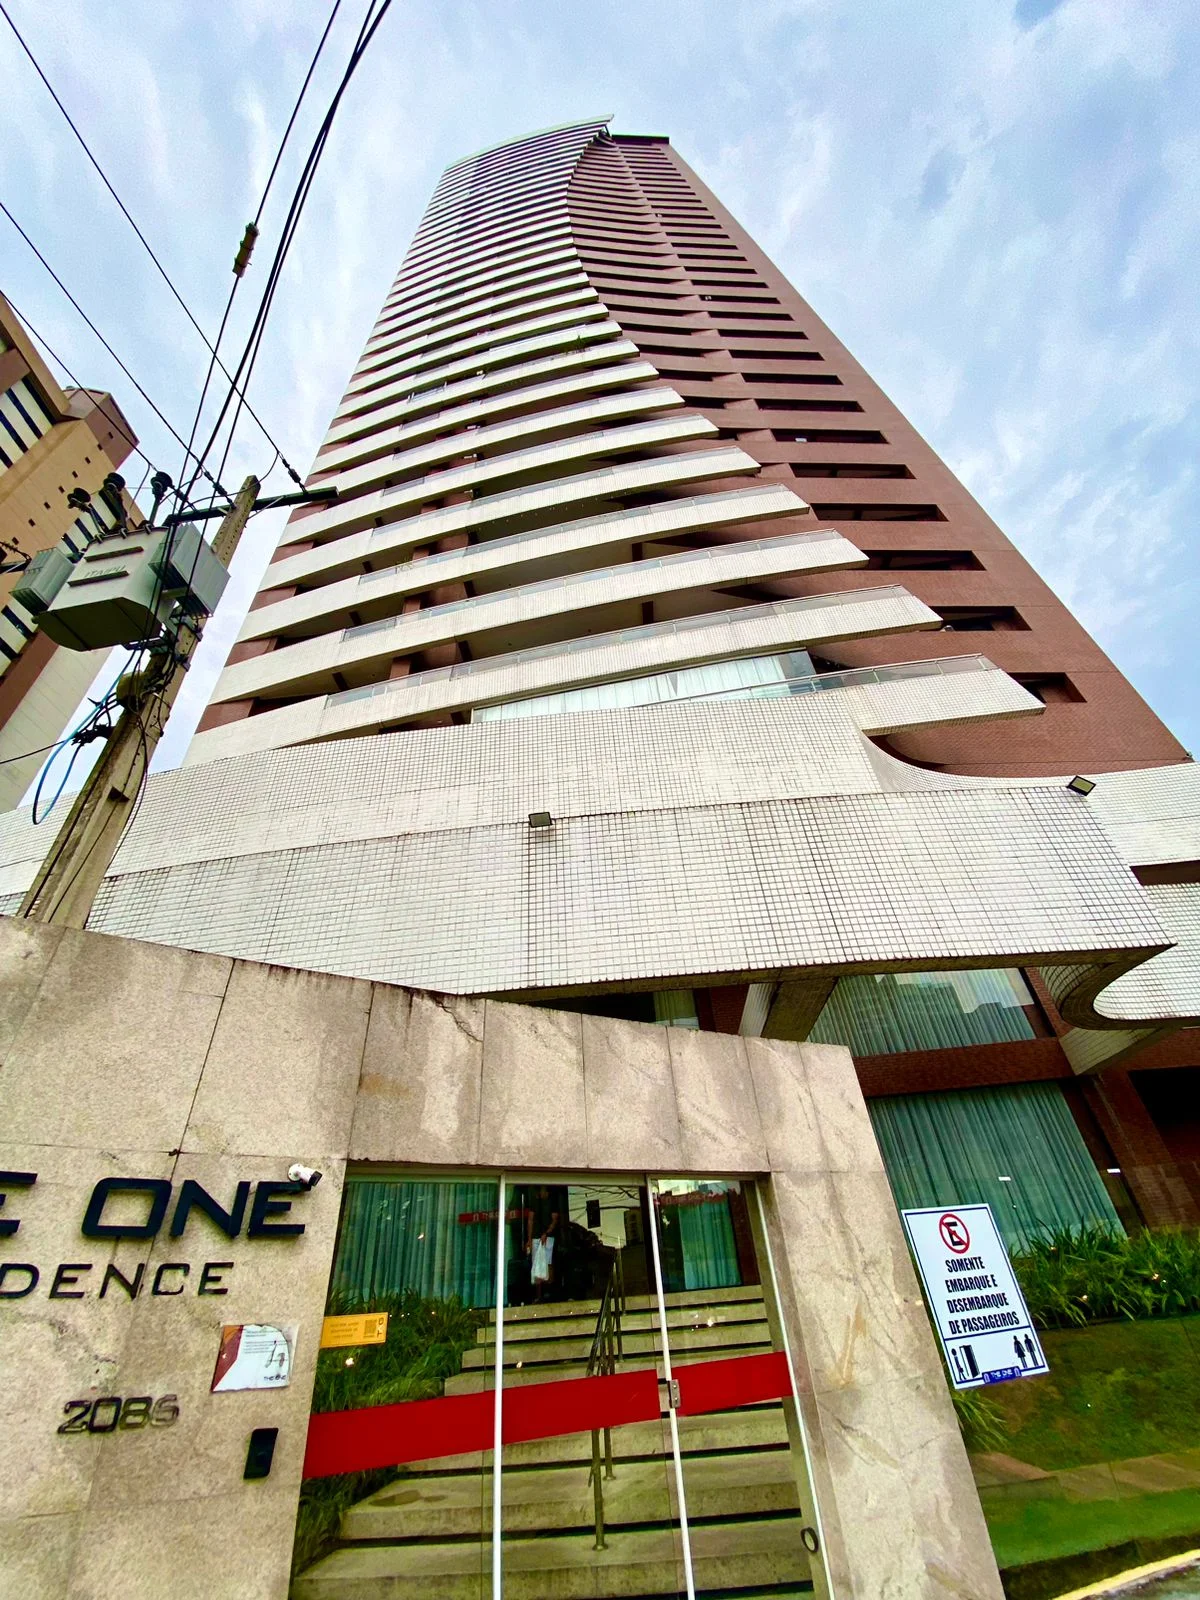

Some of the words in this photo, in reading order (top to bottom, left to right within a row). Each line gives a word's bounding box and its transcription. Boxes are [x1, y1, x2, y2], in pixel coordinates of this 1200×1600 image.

[81, 1177, 311, 1238] ONE
[945, 1256, 985, 1273] SOMENTE
[0, 1261, 235, 1300] DENCE
[945, 1275, 992, 1293] EMBARQUE
[990, 1274, 998, 1287] E
[946, 1293, 1009, 1314] DESEMBARQUE
[948, 1320, 962, 1335] DE
[960, 1311, 1020, 1333] PASSAGEIROS
